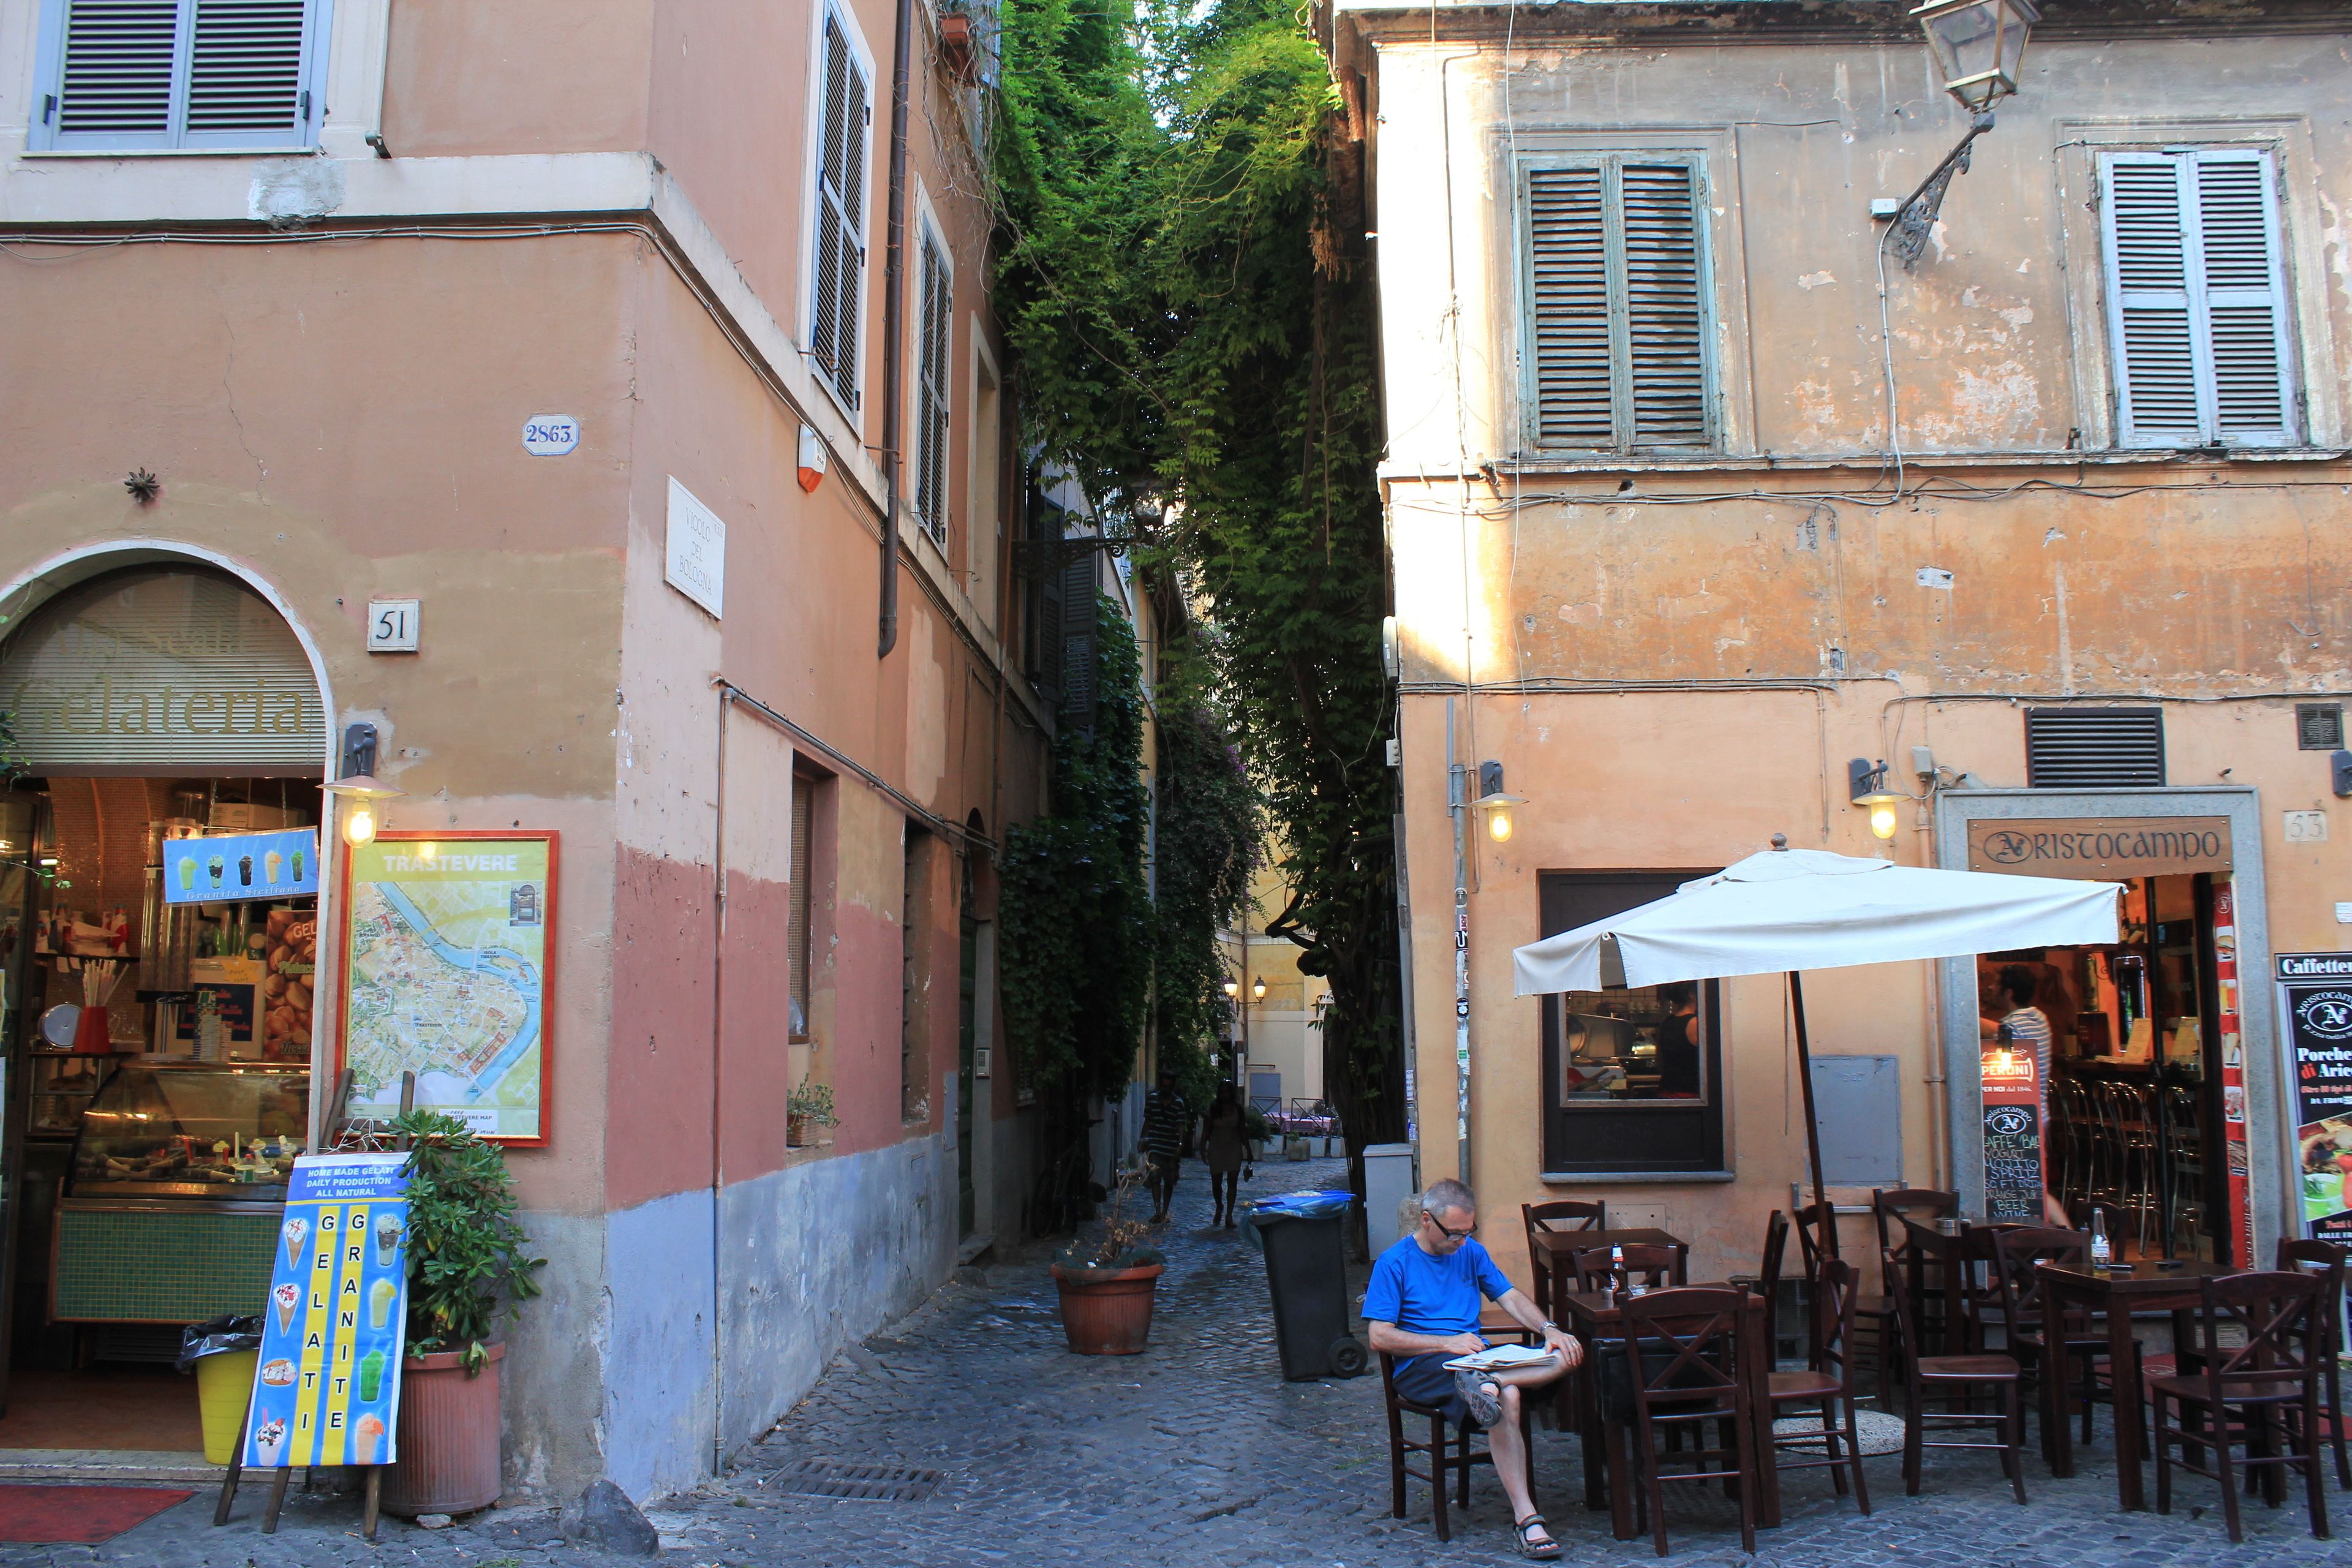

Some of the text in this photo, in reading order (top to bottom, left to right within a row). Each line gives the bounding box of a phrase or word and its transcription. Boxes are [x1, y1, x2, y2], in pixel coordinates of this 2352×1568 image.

[526, 424, 571, 442] 2863
[685, 507, 712, 543] VICOLO
[692, 540, 703, 562] DEL
[679, 554, 712, 595] BOLOGNA
[375, 610, 405, 639] 51
[11, 675, 306, 735] Gelateria
[382, 854, 519, 873] TRASTEVERE
[186, 885, 301, 900] Granita Siciliana
[2296, 1047, 2352, 1061] Porche
[1981, 1065, 2029, 1076] PERONI
[2301, 1063, 2317, 1079] di
[1984, 1148, 2026, 1159] YOGURT
[307, 1169, 333, 1177] HOME
[362, 1166, 394, 1175] GELATI
[1990, 1167, 2040, 1180] SPRITZ
[306, 1177, 391, 1188] DAILY PRODUCTION
[336, 1188, 377, 1197] NATURAL
[1994, 1199, 2030, 1211] BEER
[301, 1215, 335, 1430] GELATI
[330, 1214, 365, 1428] GRANITE
